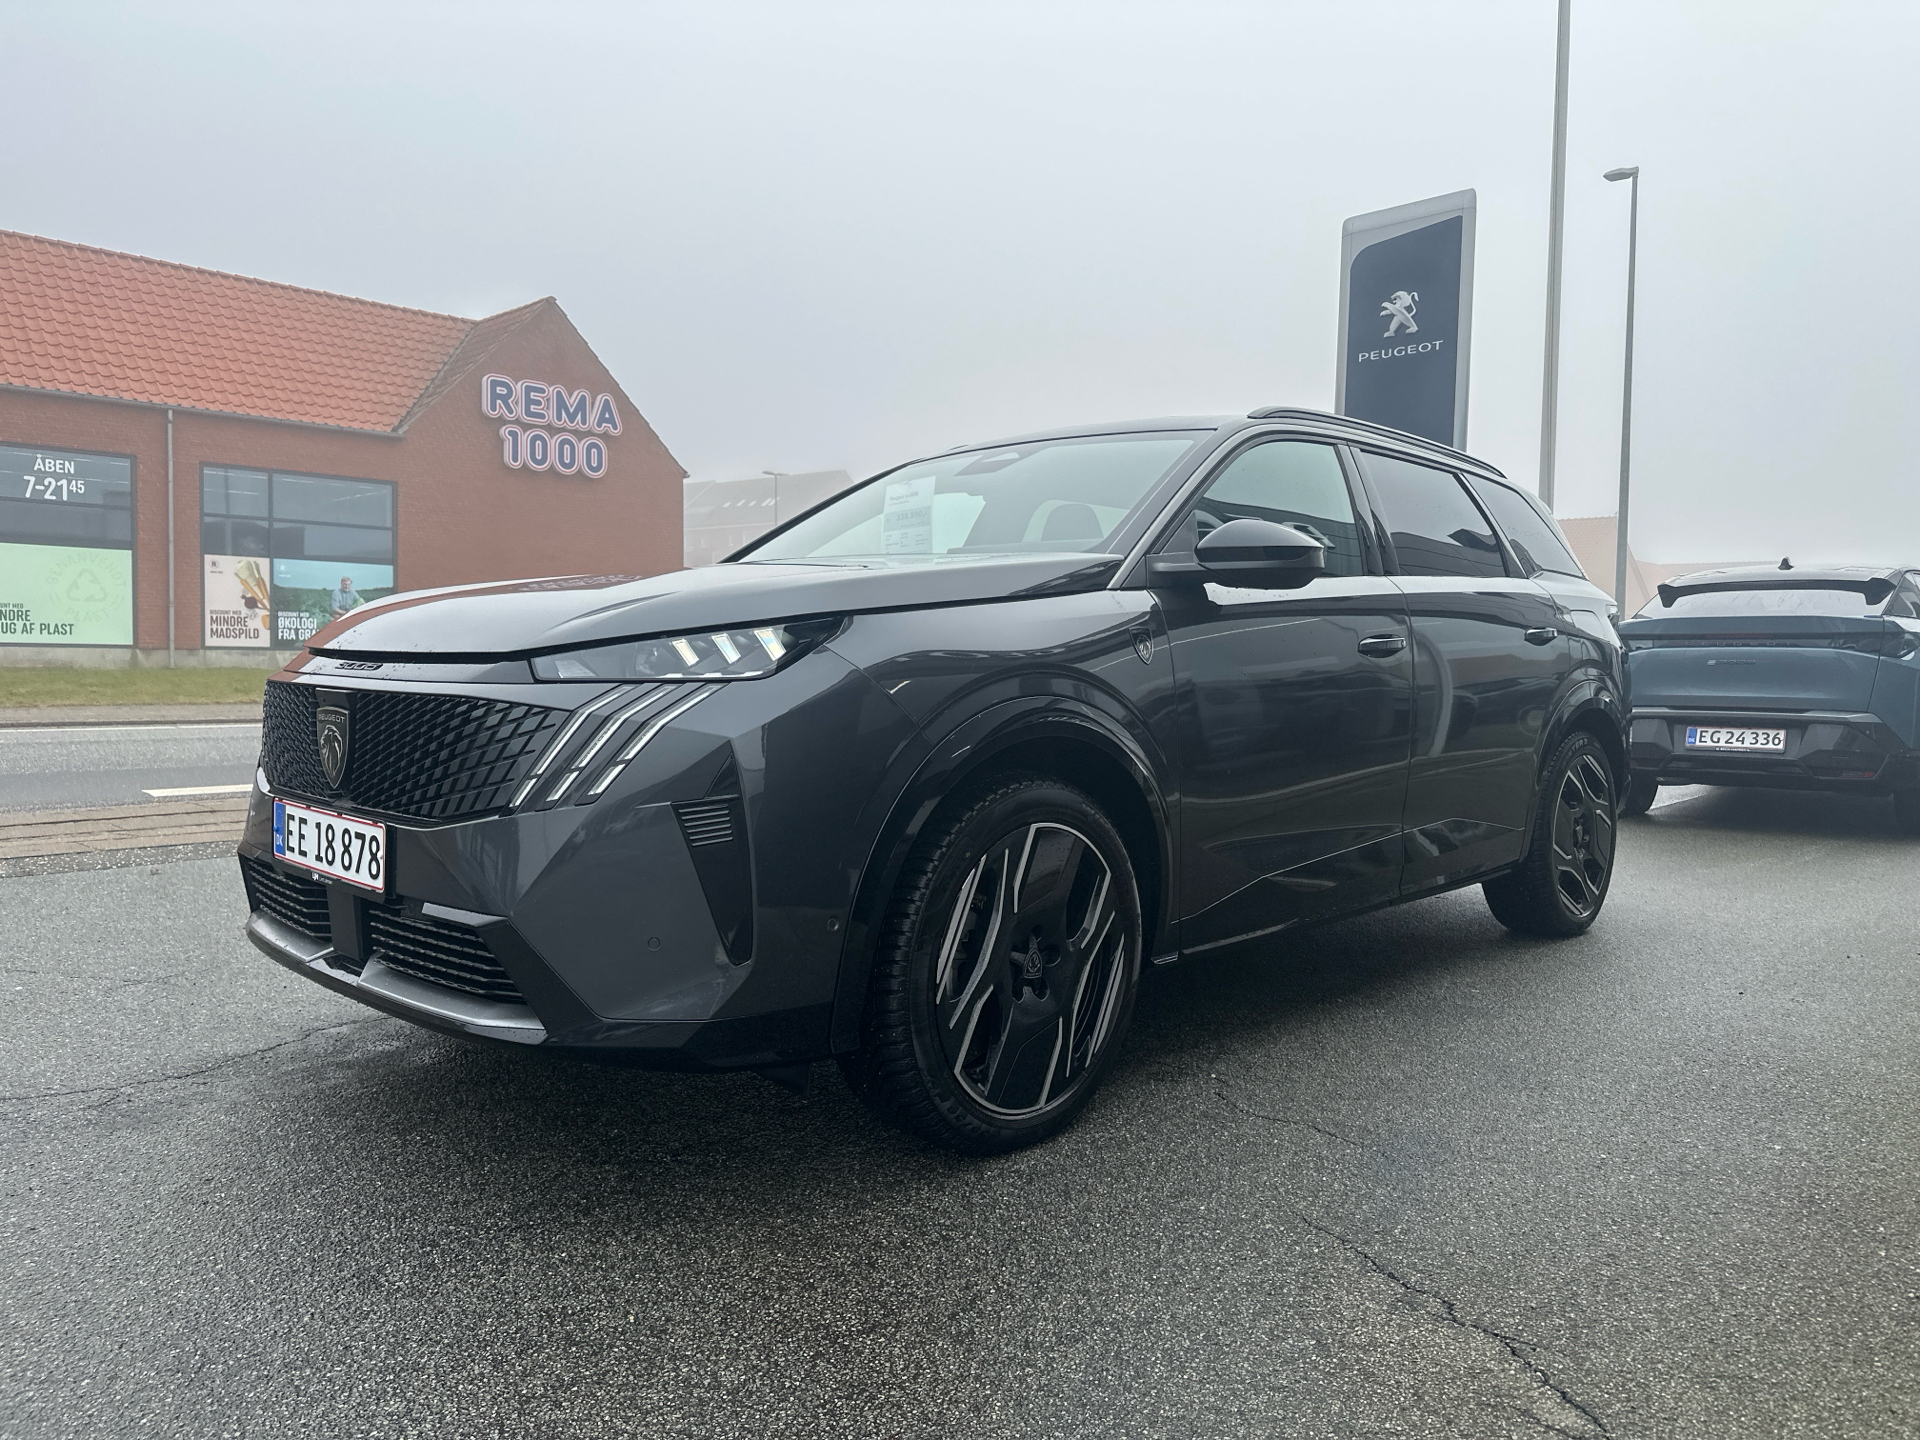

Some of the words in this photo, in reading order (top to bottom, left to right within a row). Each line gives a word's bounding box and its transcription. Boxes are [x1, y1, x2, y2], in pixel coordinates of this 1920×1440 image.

[1358, 340, 1444, 362] PEUGEOT
[483, 374, 622, 435] REMA
[500, 425, 607, 478] 1000
[33, 453, 75, 474] ÅBEN
[21, 622, 35, 635] AF
[39, 622, 74, 635] PLAST
[210, 615, 249, 628] MINDRE
[278, 617, 317, 630] ØKOLOGI
[210, 627, 260, 639] MADSPILD
[278, 629, 296, 640] FRA
[318, 713, 345, 724] PEUGEOT
[1698, 730, 1722, 744] EG
[1724, 731, 1746, 745] 24
[1749, 732, 1782, 747] 336
[286, 813, 308, 858] EE
[315, 822, 336, 866] 18
[341, 827, 381, 880] 878
